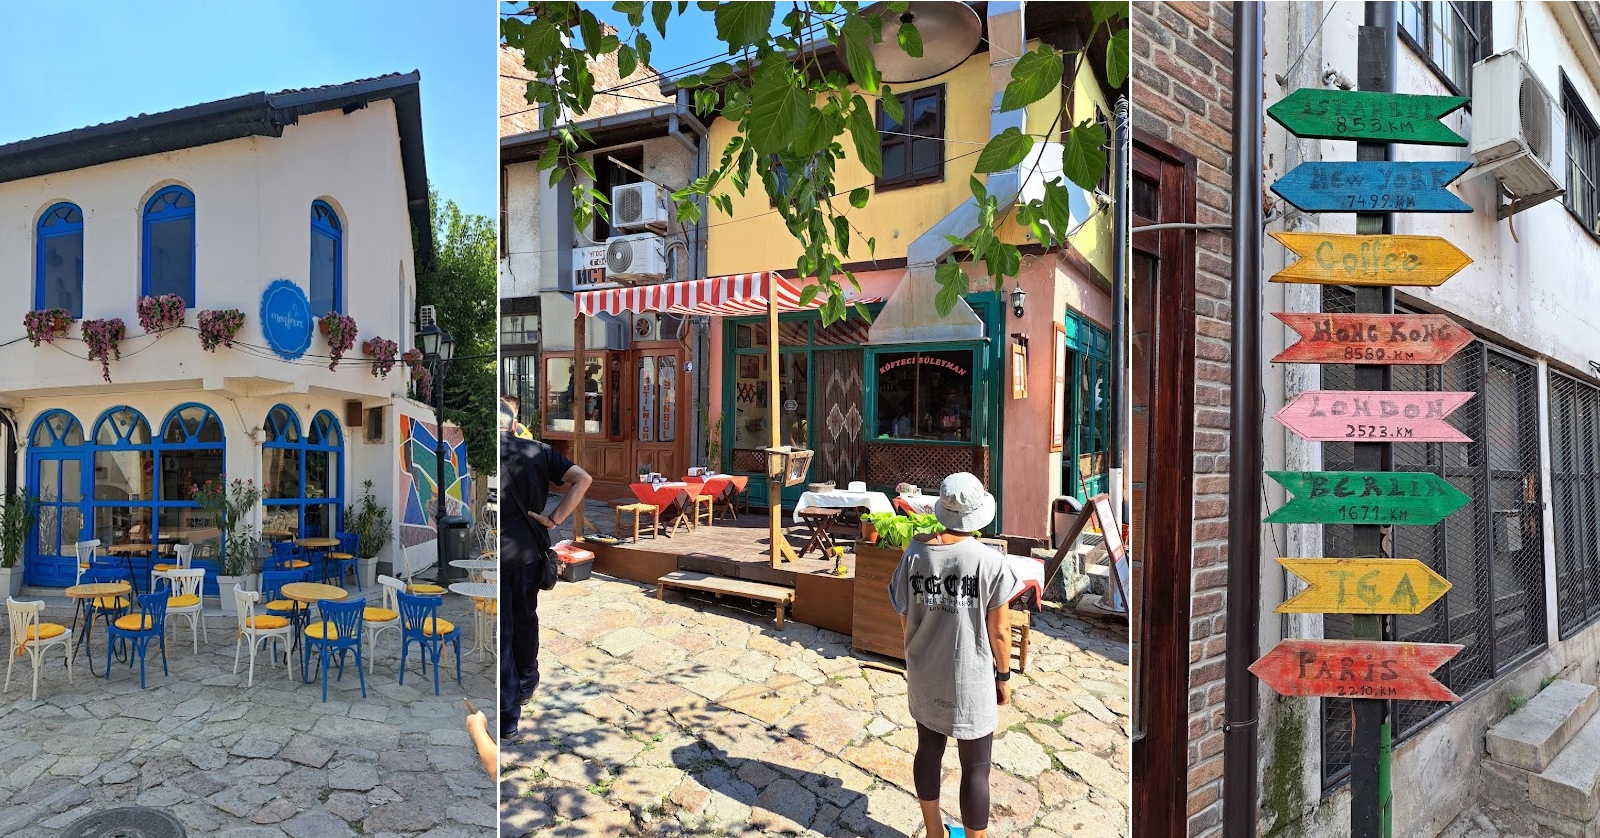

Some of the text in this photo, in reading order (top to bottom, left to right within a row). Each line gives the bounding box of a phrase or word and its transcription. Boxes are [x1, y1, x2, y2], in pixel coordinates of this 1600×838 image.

[1315, 240, 1422, 276] Coffee
[1308, 319, 1452, 343] HONG KONG
[1307, 396, 1444, 418] LONDON
[1345, 424, 1414, 438] 2523.KM
[1310, 475, 1448, 499] BERLIN
[1327, 569, 1420, 613] TEA
